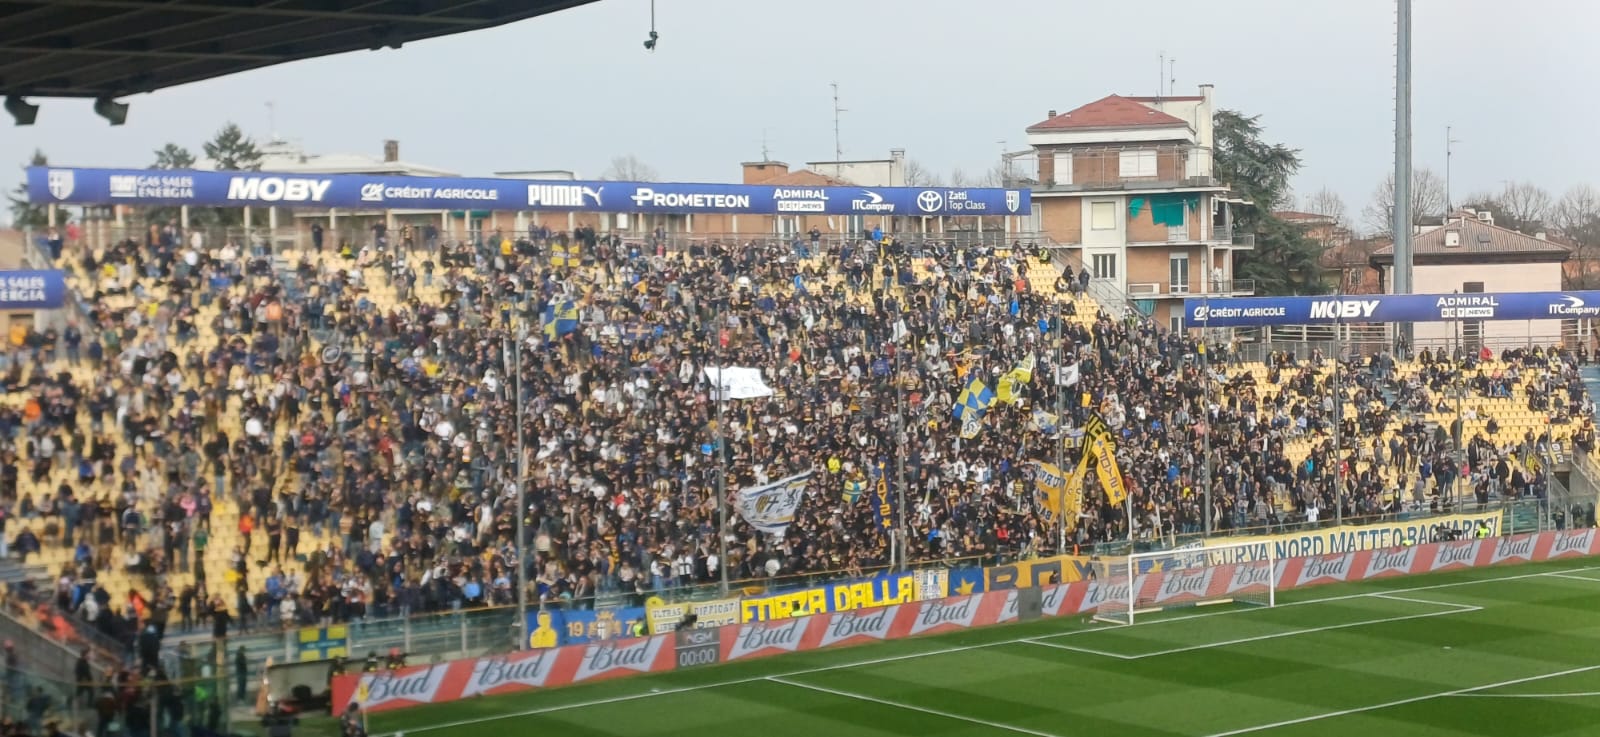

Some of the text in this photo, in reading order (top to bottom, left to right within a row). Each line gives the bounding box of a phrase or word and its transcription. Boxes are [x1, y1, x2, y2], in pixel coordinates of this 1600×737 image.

[137, 176, 193, 187] GAS SALES
[138, 187, 194, 198] ENERGIA
[227, 177, 331, 201] MOBY
[385, 186, 433, 199] CRÉDIT
[434, 188, 497, 200] AGRICOLE
[527, 184, 585, 206] PUMA
[634, 188, 750, 208] PROMETEON
[773, 188, 829, 200] ADMIRAL
[949, 191, 968, 200] Zatti
[949, 201, 986, 211] Top Class
[1210, 307, 1241, 318] CRÉDIT
[1242, 307, 1285, 317] AGRICOLE
[1309, 300, 1380, 318] MOBY
[1437, 296, 1499, 307] ADMIRAL
[1210, 544, 1268, 565] CURVA
[1275, 536, 1324, 559] NORD
[1330, 528, 1403, 553] MATTEO
[1439, 541, 1474, 563] Bud
[1496, 534, 1529, 557] Bud
[1553, 531, 1587, 551] Bud
[1305, 555, 1346, 578] Bud
[1372, 549, 1409, 570] Bud
[1164, 569, 1205, 594] Bud
[742, 589, 825, 624] FORZA
[834, 576, 913, 611] DALLA
[831, 606, 885, 638] Bud
[921, 597, 971, 626] Bud
[739, 619, 798, 650] Bud
[583, 637, 650, 671] Bud
[680, 649, 716, 666] 00:00
[474, 652, 544, 686] Bud
[366, 664, 434, 700] Bud
